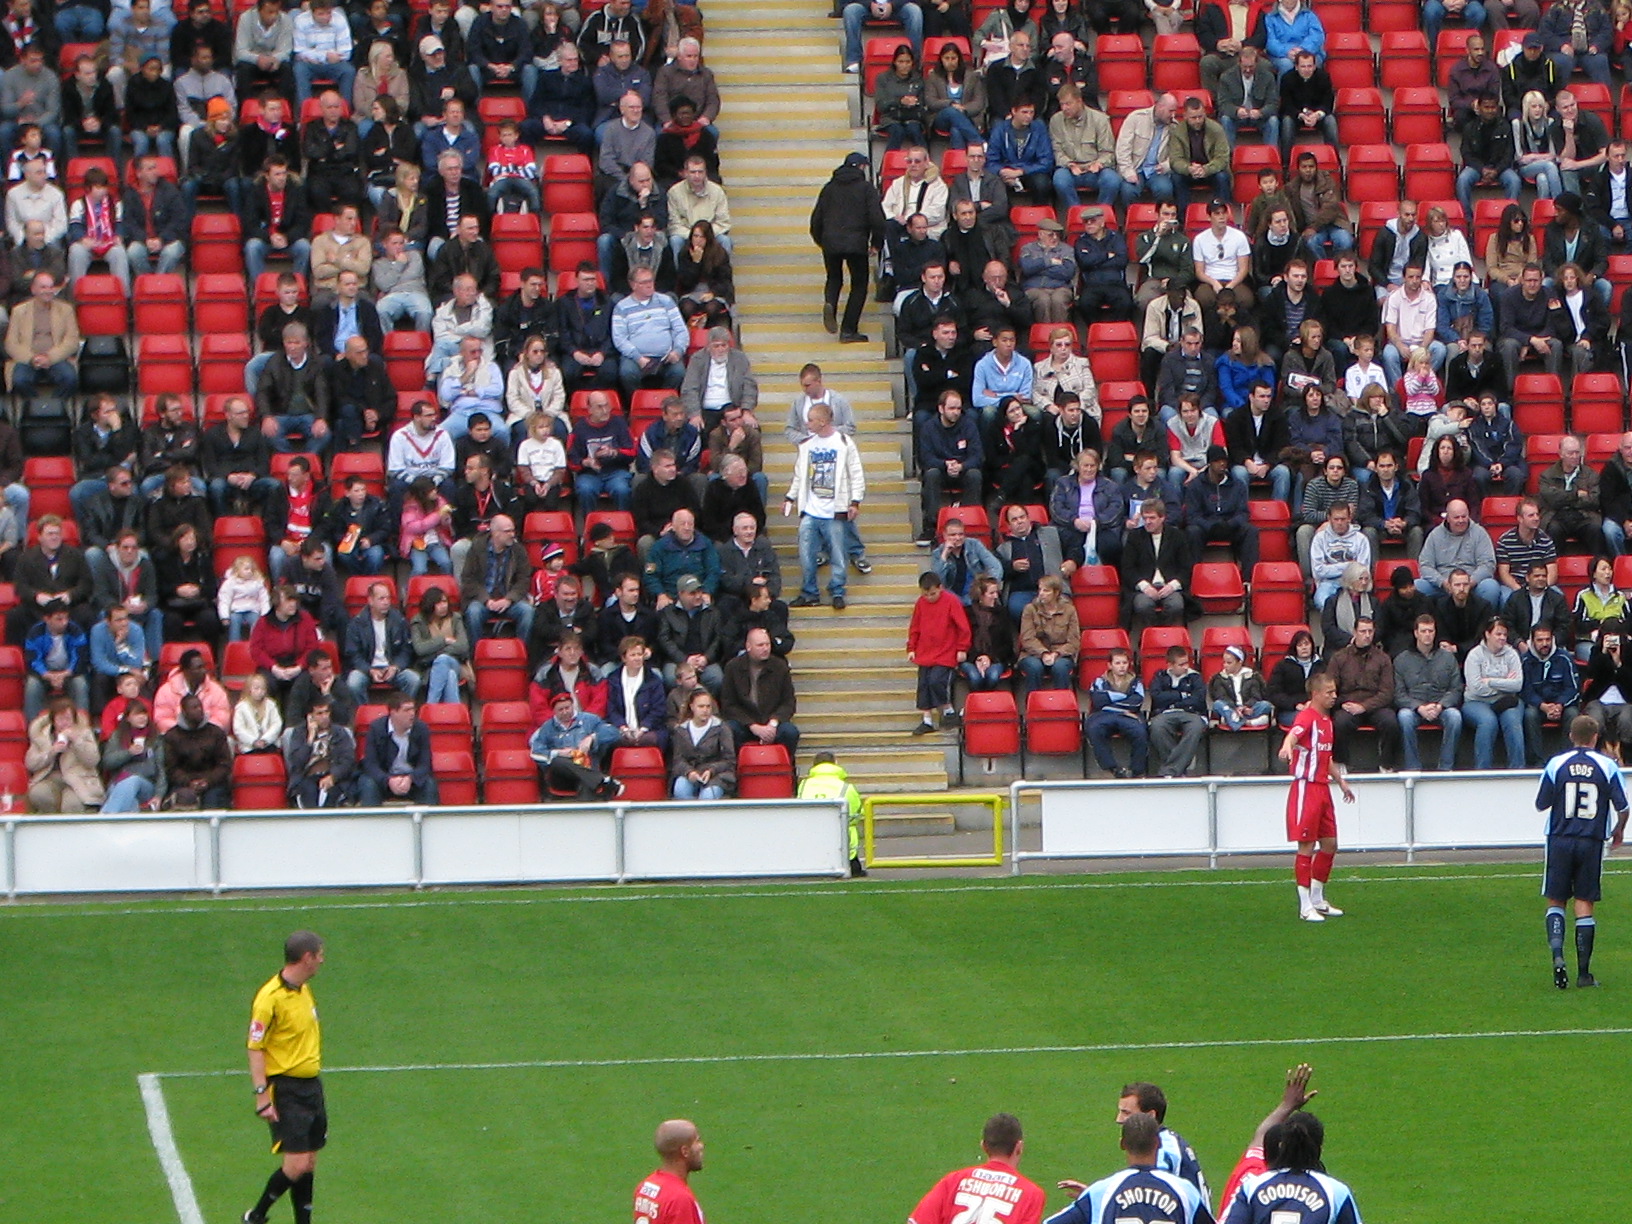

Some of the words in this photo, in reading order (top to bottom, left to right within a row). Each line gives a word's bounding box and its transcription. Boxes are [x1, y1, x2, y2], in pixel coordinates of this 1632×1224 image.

[1565, 782, 1599, 820] 13
[958, 1178, 1023, 1204] ASHWORTH
[1115, 1187, 1178, 1216] SHOTTON
[1257, 1183, 1325, 1213] GOODISON
